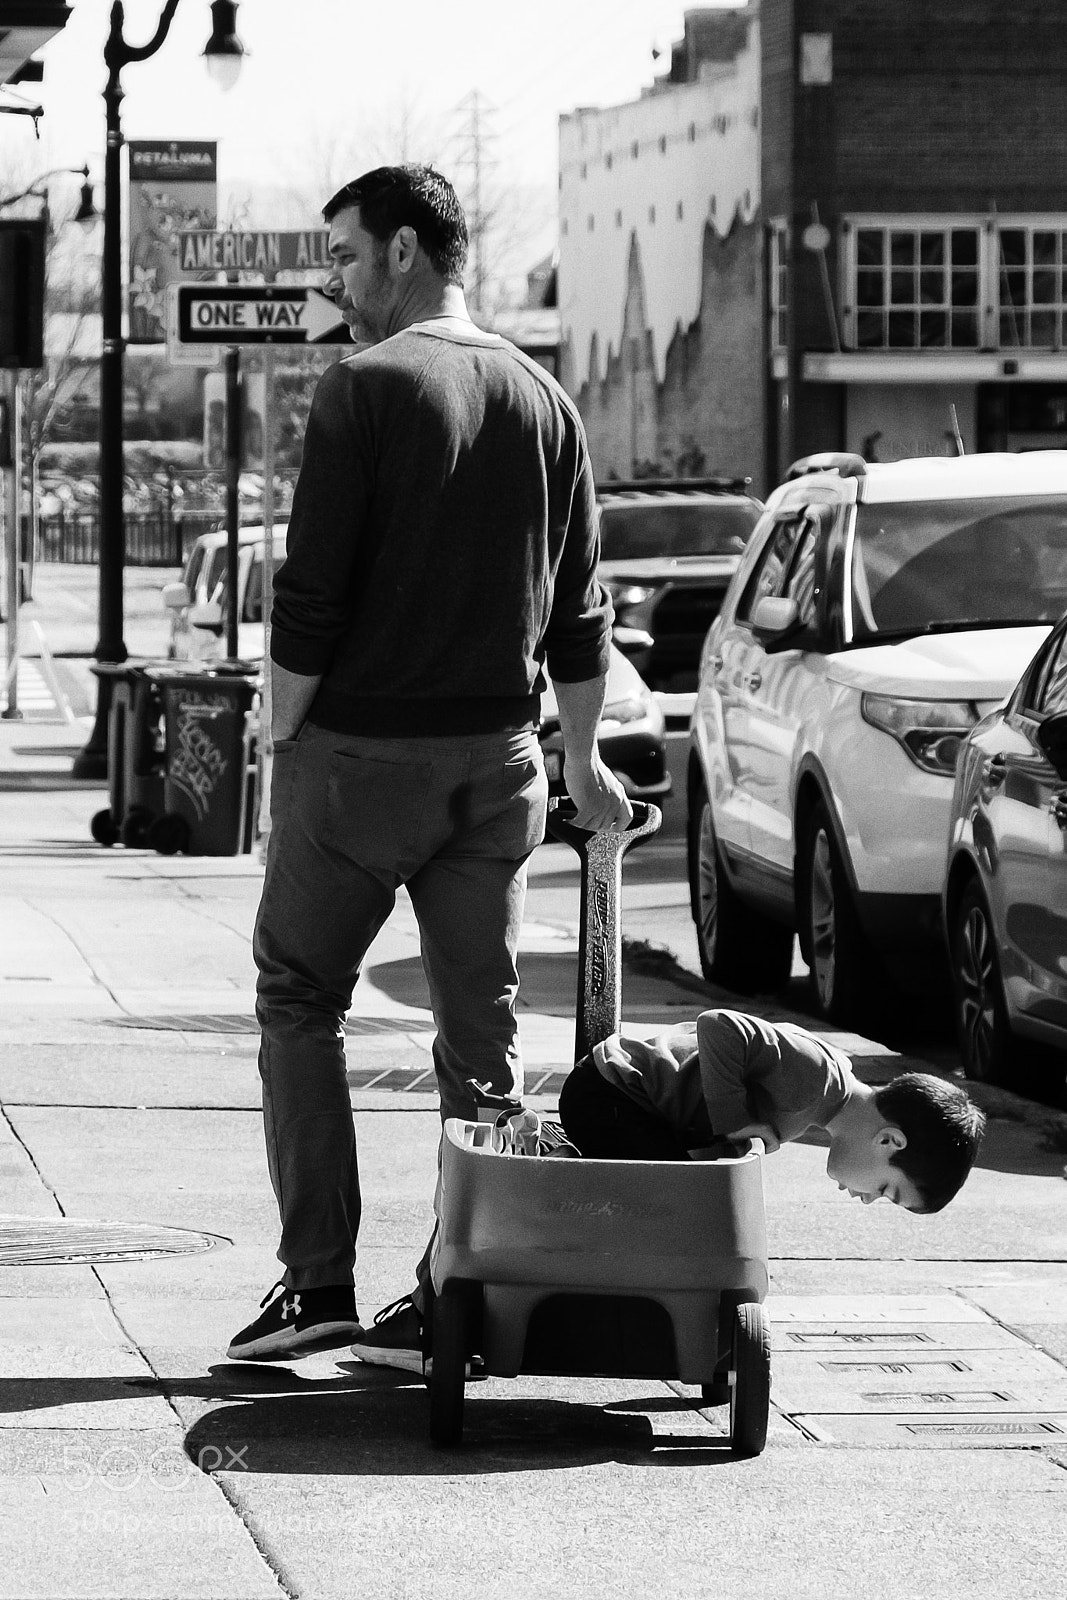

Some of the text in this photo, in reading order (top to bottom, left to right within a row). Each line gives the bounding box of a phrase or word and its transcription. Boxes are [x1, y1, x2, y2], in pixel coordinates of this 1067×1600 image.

[133, 151, 213, 166] PETALUMA
[184, 232, 280, 267] AMERICAN
[198, 302, 306, 326] ONE WAY
